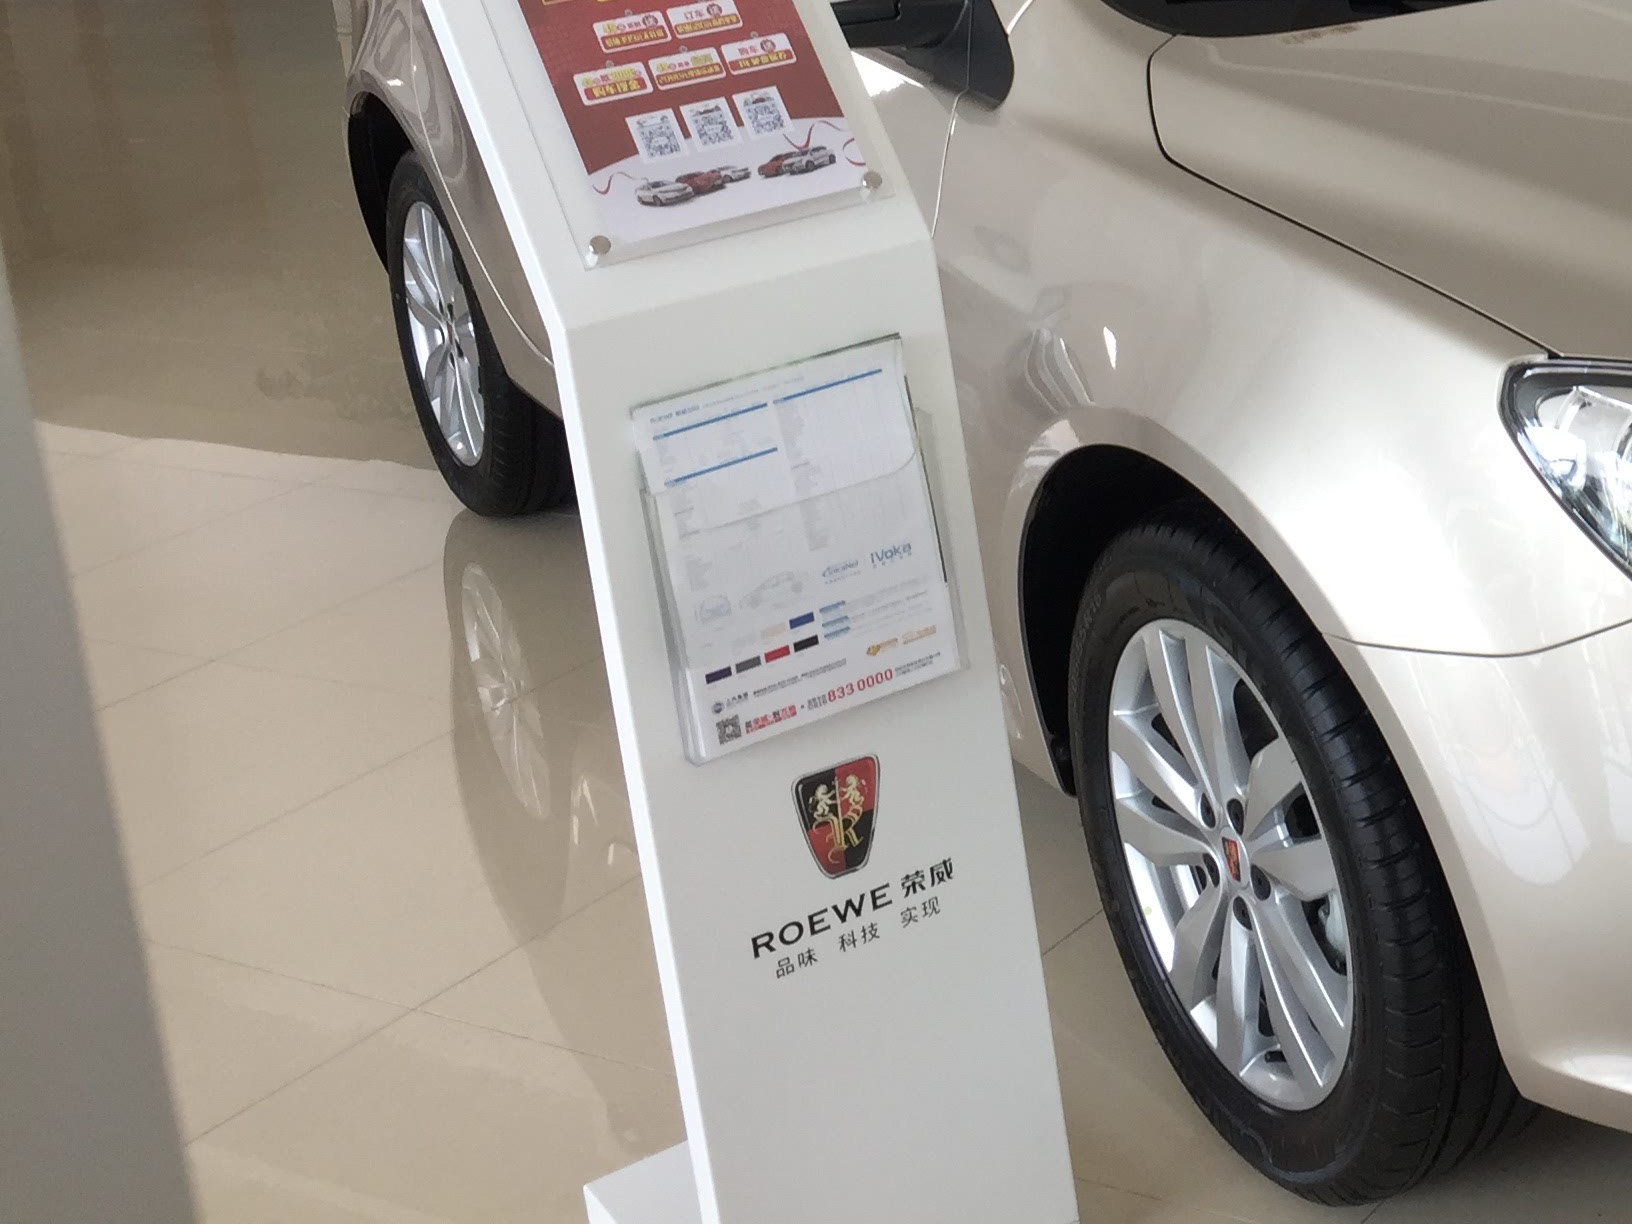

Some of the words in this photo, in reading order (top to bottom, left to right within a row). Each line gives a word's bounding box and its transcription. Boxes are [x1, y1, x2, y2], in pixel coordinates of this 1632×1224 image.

[828, 684, 855, 703] 833
[857, 668, 894, 692] 0000
[751, 883, 893, 959] ROEWE
[901, 858, 954, 898] 荣威
[775, 947, 818, 979] 品味
[839, 923, 881, 952] 科技
[901, 896, 941, 928] 实现
